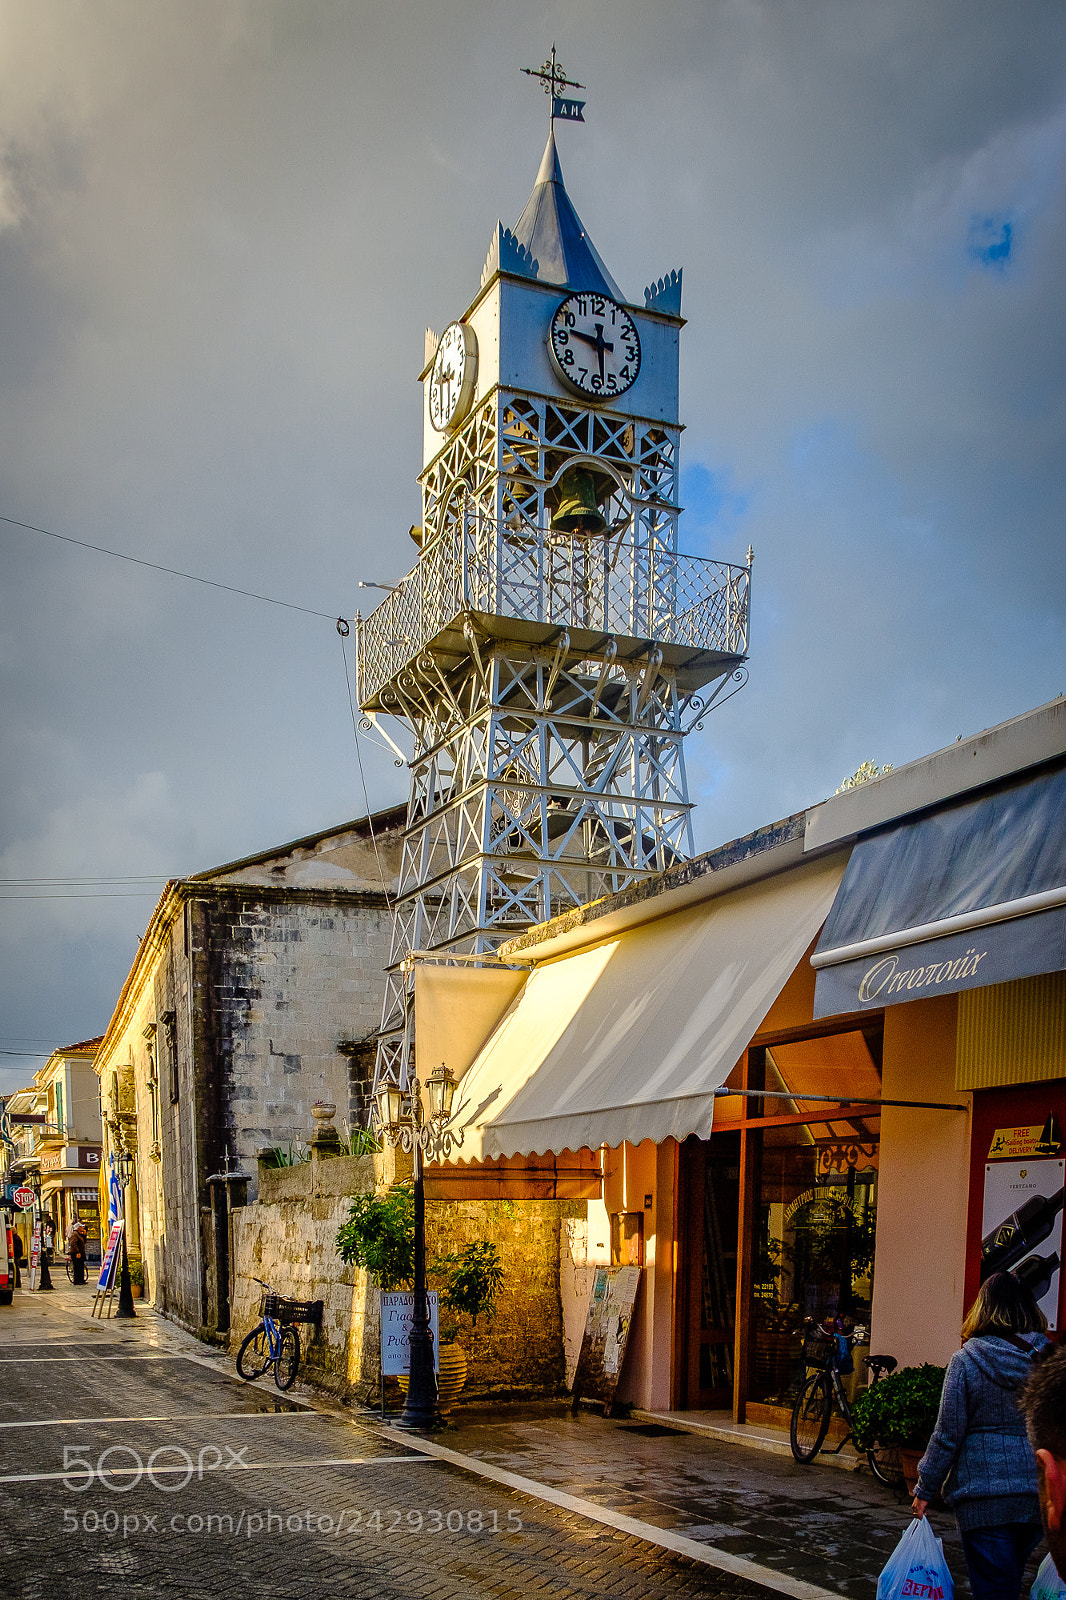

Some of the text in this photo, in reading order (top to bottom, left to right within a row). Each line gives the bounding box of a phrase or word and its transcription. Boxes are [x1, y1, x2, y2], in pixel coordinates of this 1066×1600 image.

[577, 299, 587, 316] 11
[590, 298, 606, 317] 12
[564, 311, 576, 328] 10
[610, 309, 616, 325] 1
[557, 330, 569, 346] 9
[620, 325, 631, 341] 2
[564, 349, 575, 366] 8
[625, 345, 636, 362] 3
[578, 367, 589, 384] 7
[619, 364, 631, 380] 4
[591, 374, 602, 390] 6
[606, 373, 617, 390] 5
[1013, 1128, 1030, 1138] FREE
[1008, 1146, 1033, 1155] DELIVERY
[16, 1192, 34, 1203] STOP
[402, 1323, 408, 1332] &
